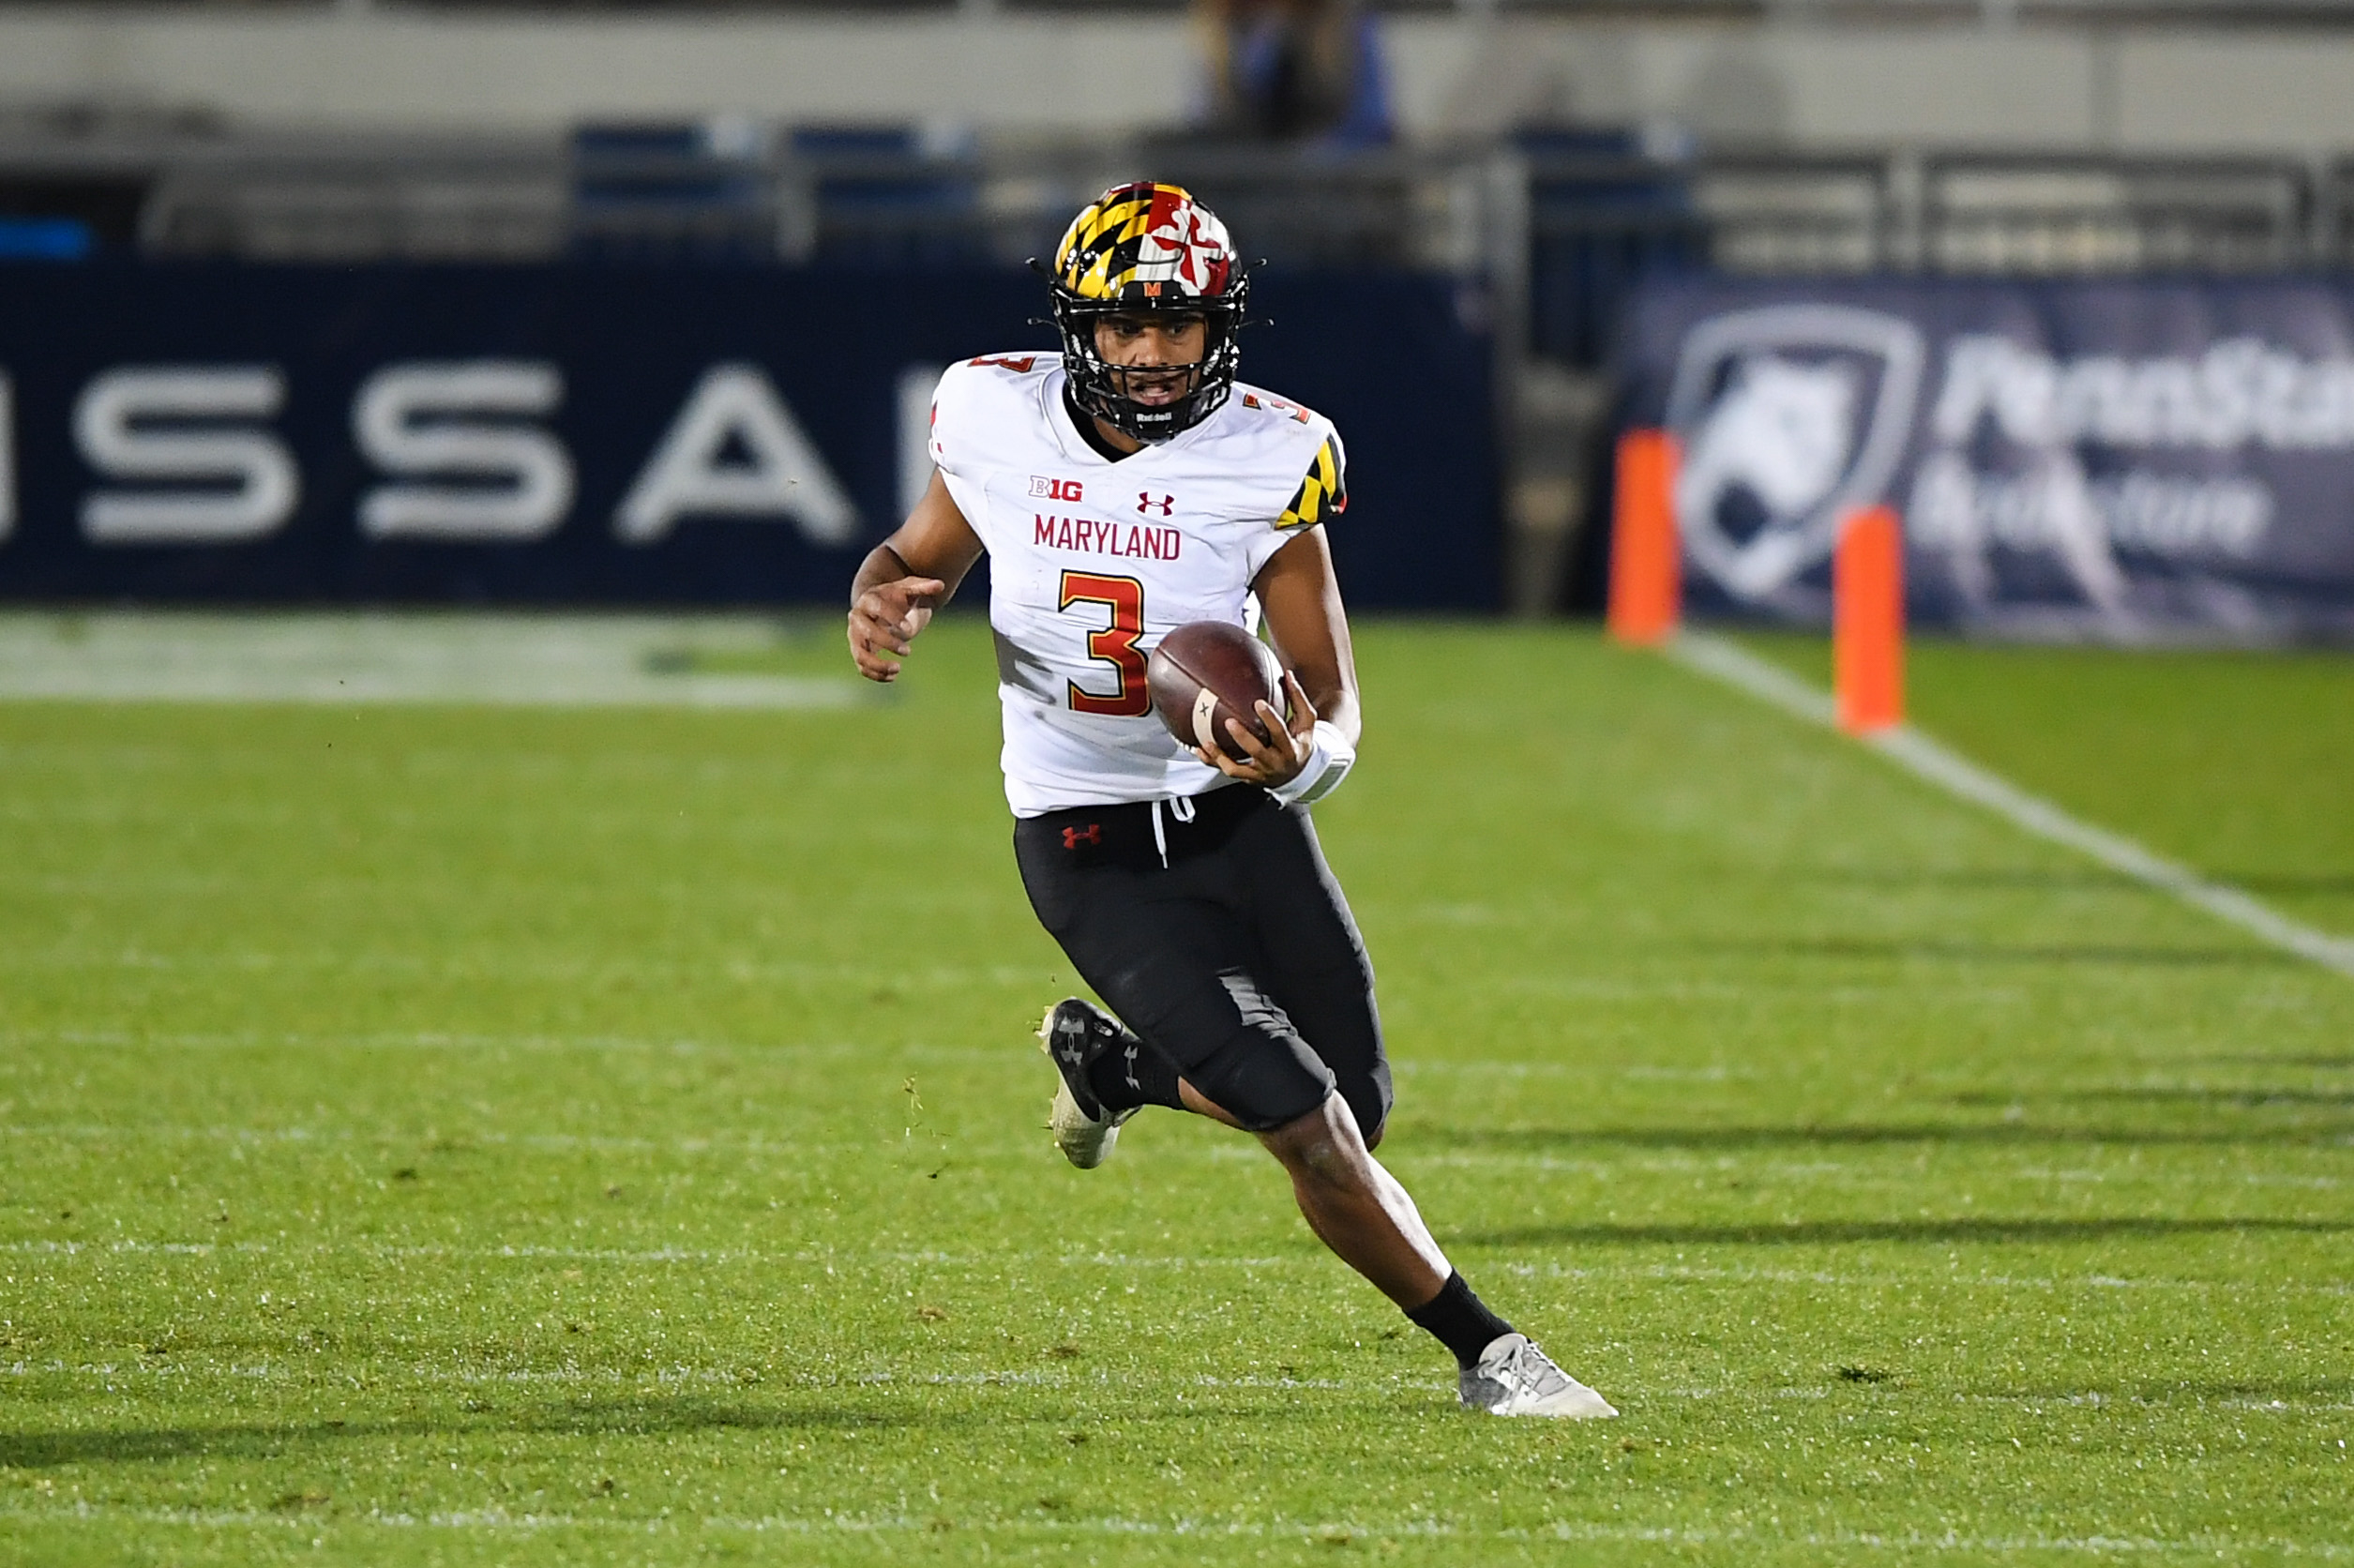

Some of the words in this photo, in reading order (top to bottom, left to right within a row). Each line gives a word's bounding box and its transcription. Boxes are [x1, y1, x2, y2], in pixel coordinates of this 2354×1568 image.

[1143, 281, 1162, 297] M
[0, 361, 938, 544] SSA
[1034, 514, 1180, 561] MARYLAND
[1058, 568, 1154, 717] 3
